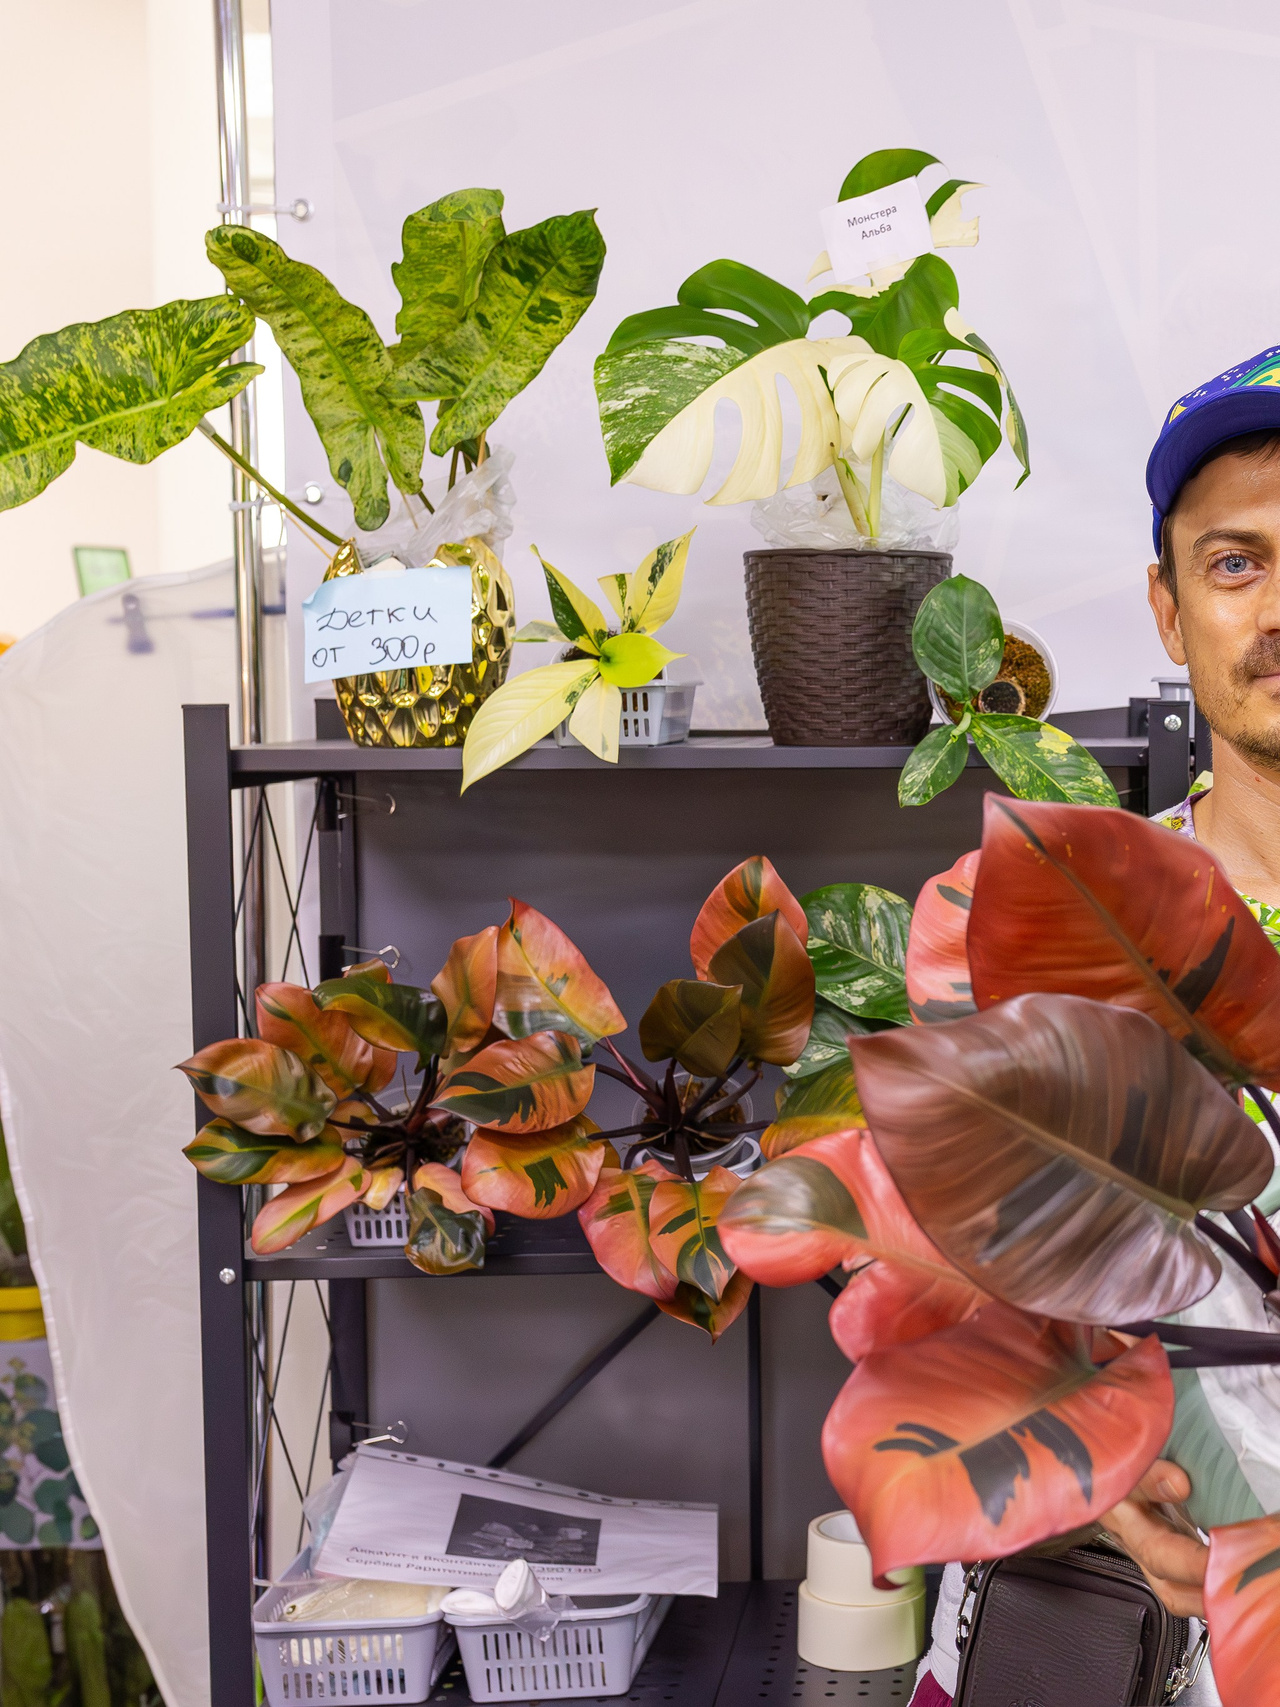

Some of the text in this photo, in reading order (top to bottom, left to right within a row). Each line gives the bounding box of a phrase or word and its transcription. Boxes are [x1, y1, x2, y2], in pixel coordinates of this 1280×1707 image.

[847, 206, 897, 228] Монстера
[861, 223, 892, 240] Альба
[316, 606, 438, 631] Детки
